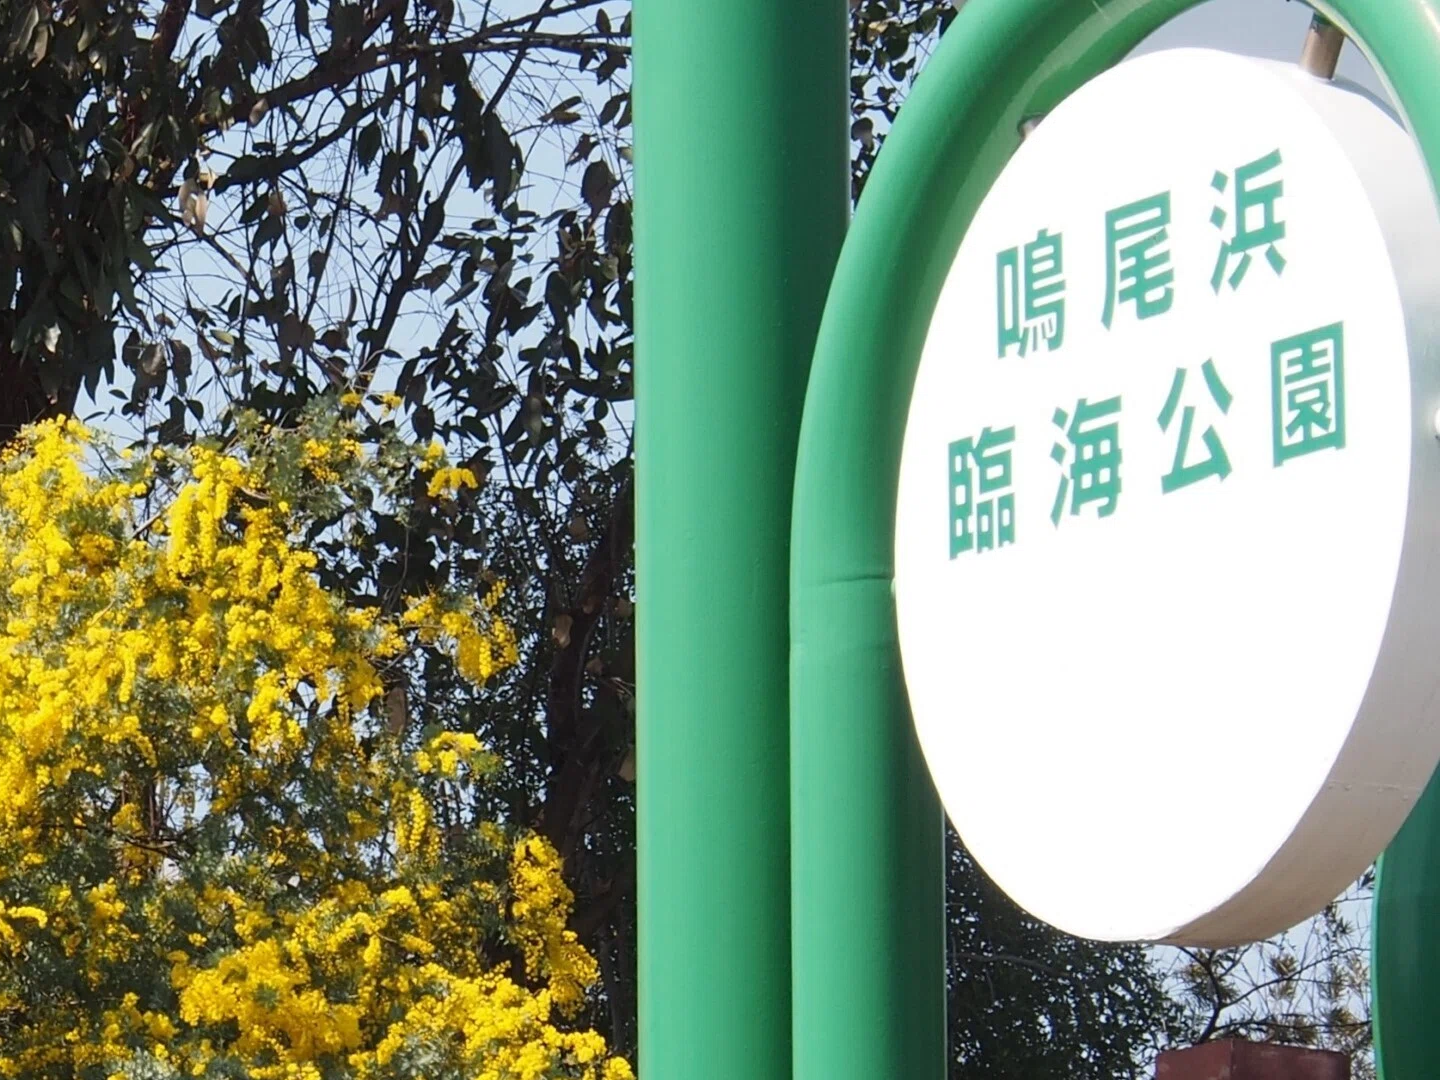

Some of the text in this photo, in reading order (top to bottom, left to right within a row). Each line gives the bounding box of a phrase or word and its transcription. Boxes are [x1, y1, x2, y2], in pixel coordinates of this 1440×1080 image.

[996, 149, 1287, 359] 鳴尾浜
[948, 321, 1347, 560] 臨海公園
